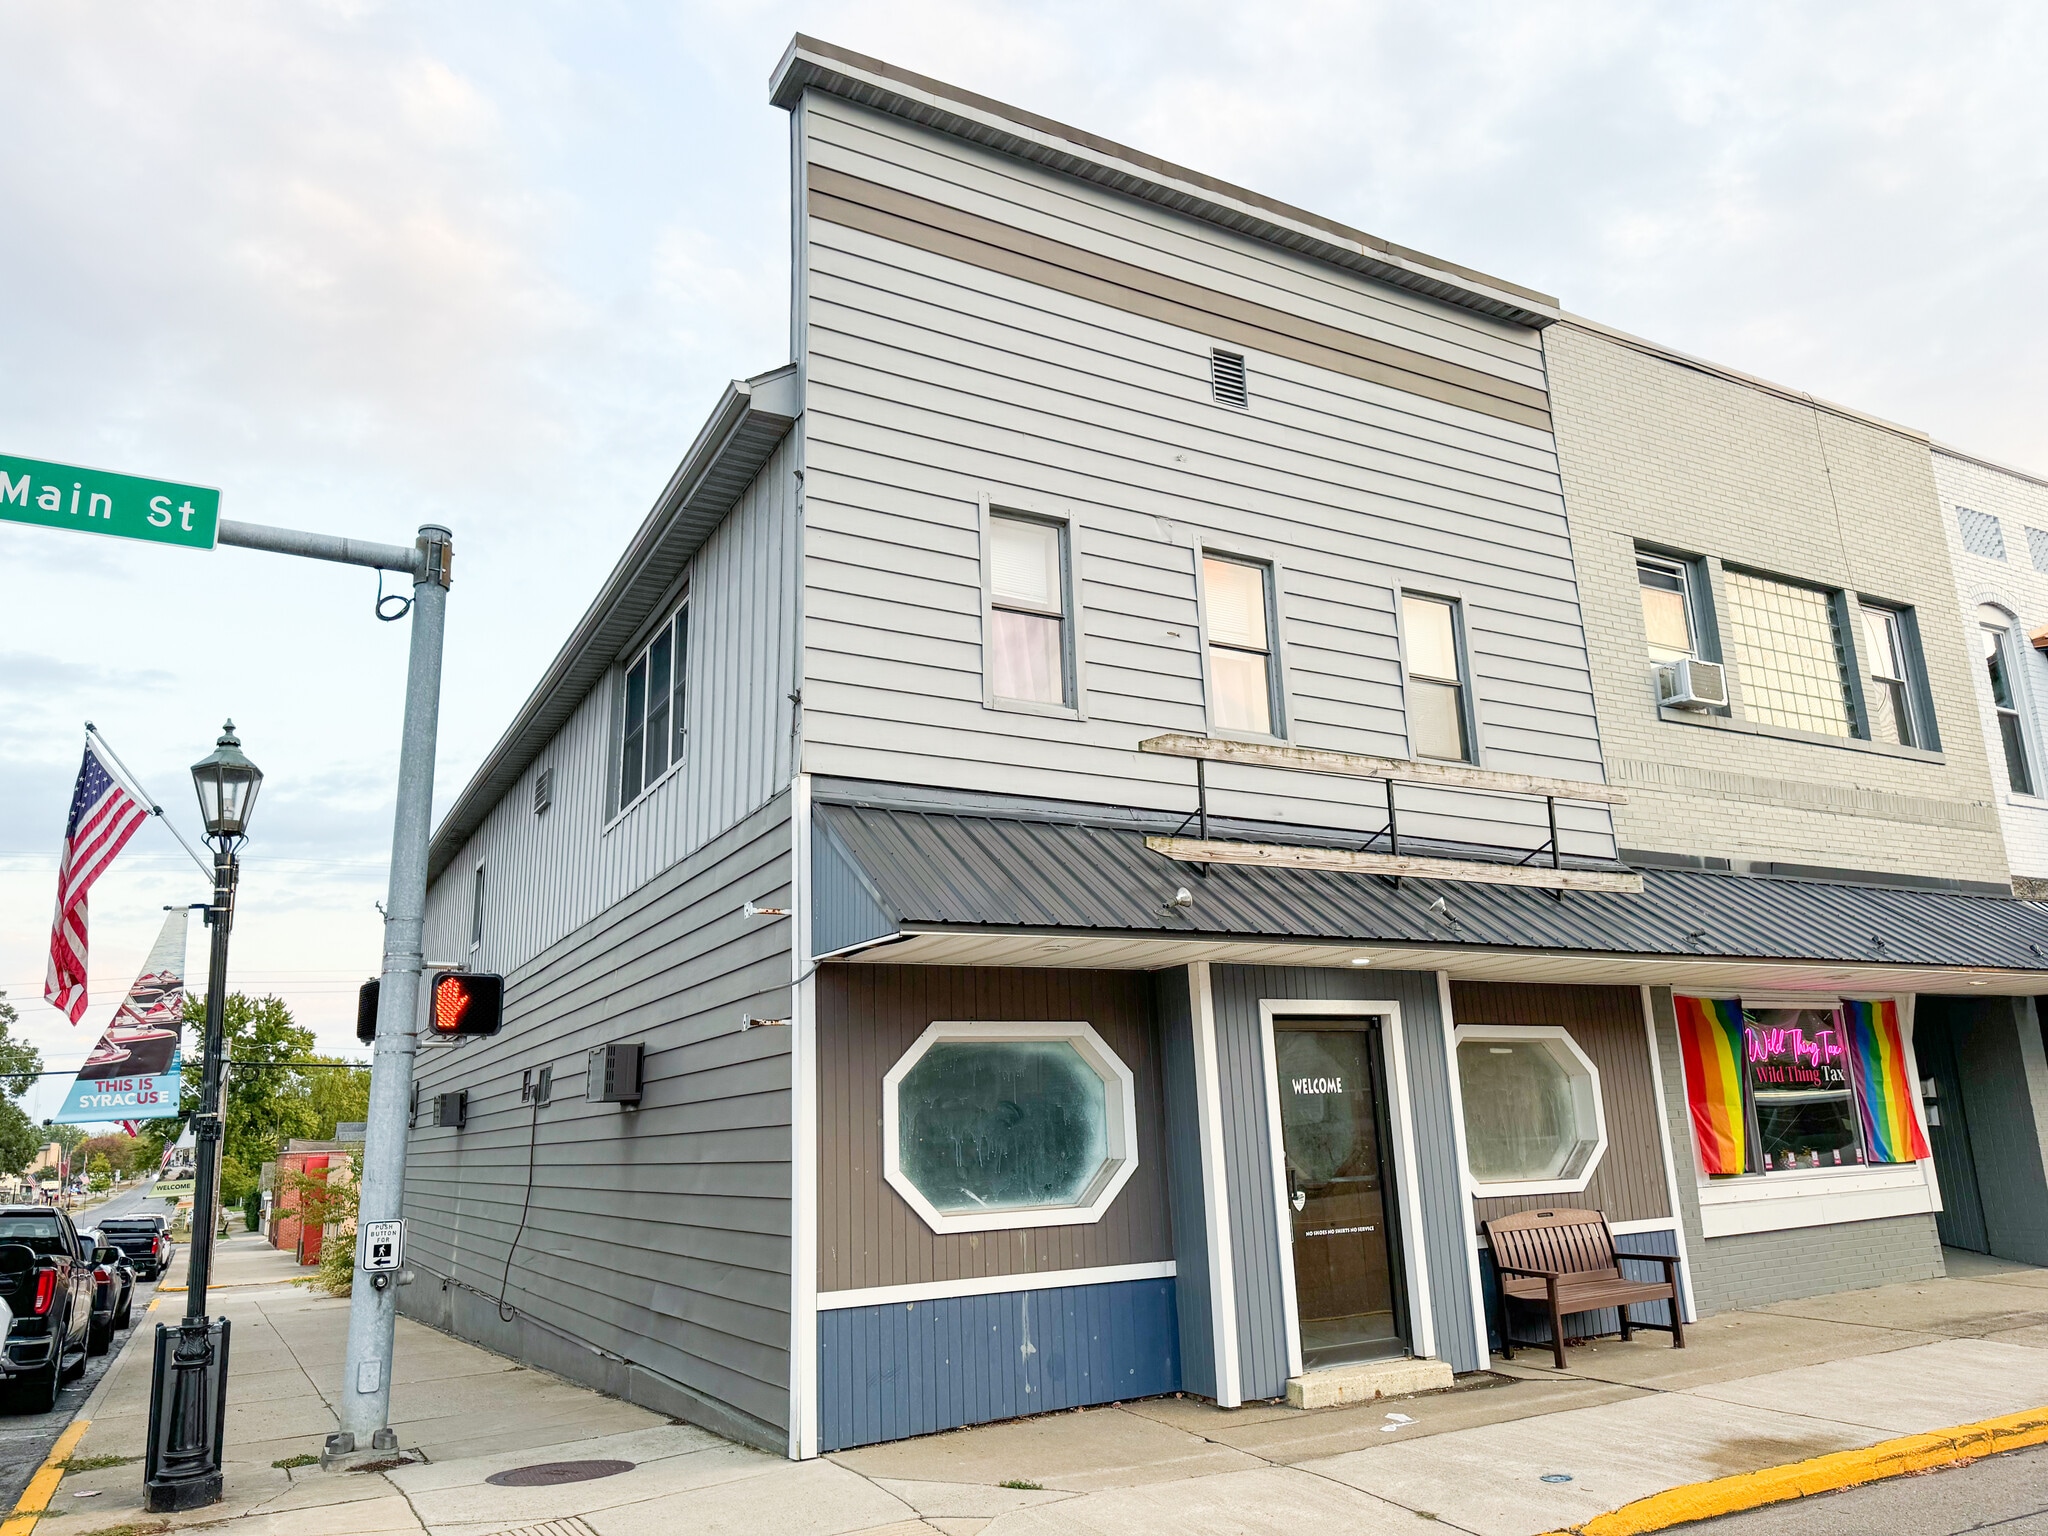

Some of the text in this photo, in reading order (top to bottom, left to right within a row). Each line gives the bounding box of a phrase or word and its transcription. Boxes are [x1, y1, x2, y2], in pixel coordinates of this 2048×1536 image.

[0, 470, 196, 532] Main St
[1745, 1028, 1842, 1067] Wild Thing Tax
[1756, 1065, 1845, 1086] Wild Thing Tax
[95, 1078, 153, 1092] THIS IS
[1292, 1077, 1342, 1094] WELCOME
[79, 1091, 169, 1108] SYRACUSE
[156, 1183, 190, 1191] WELCOME
